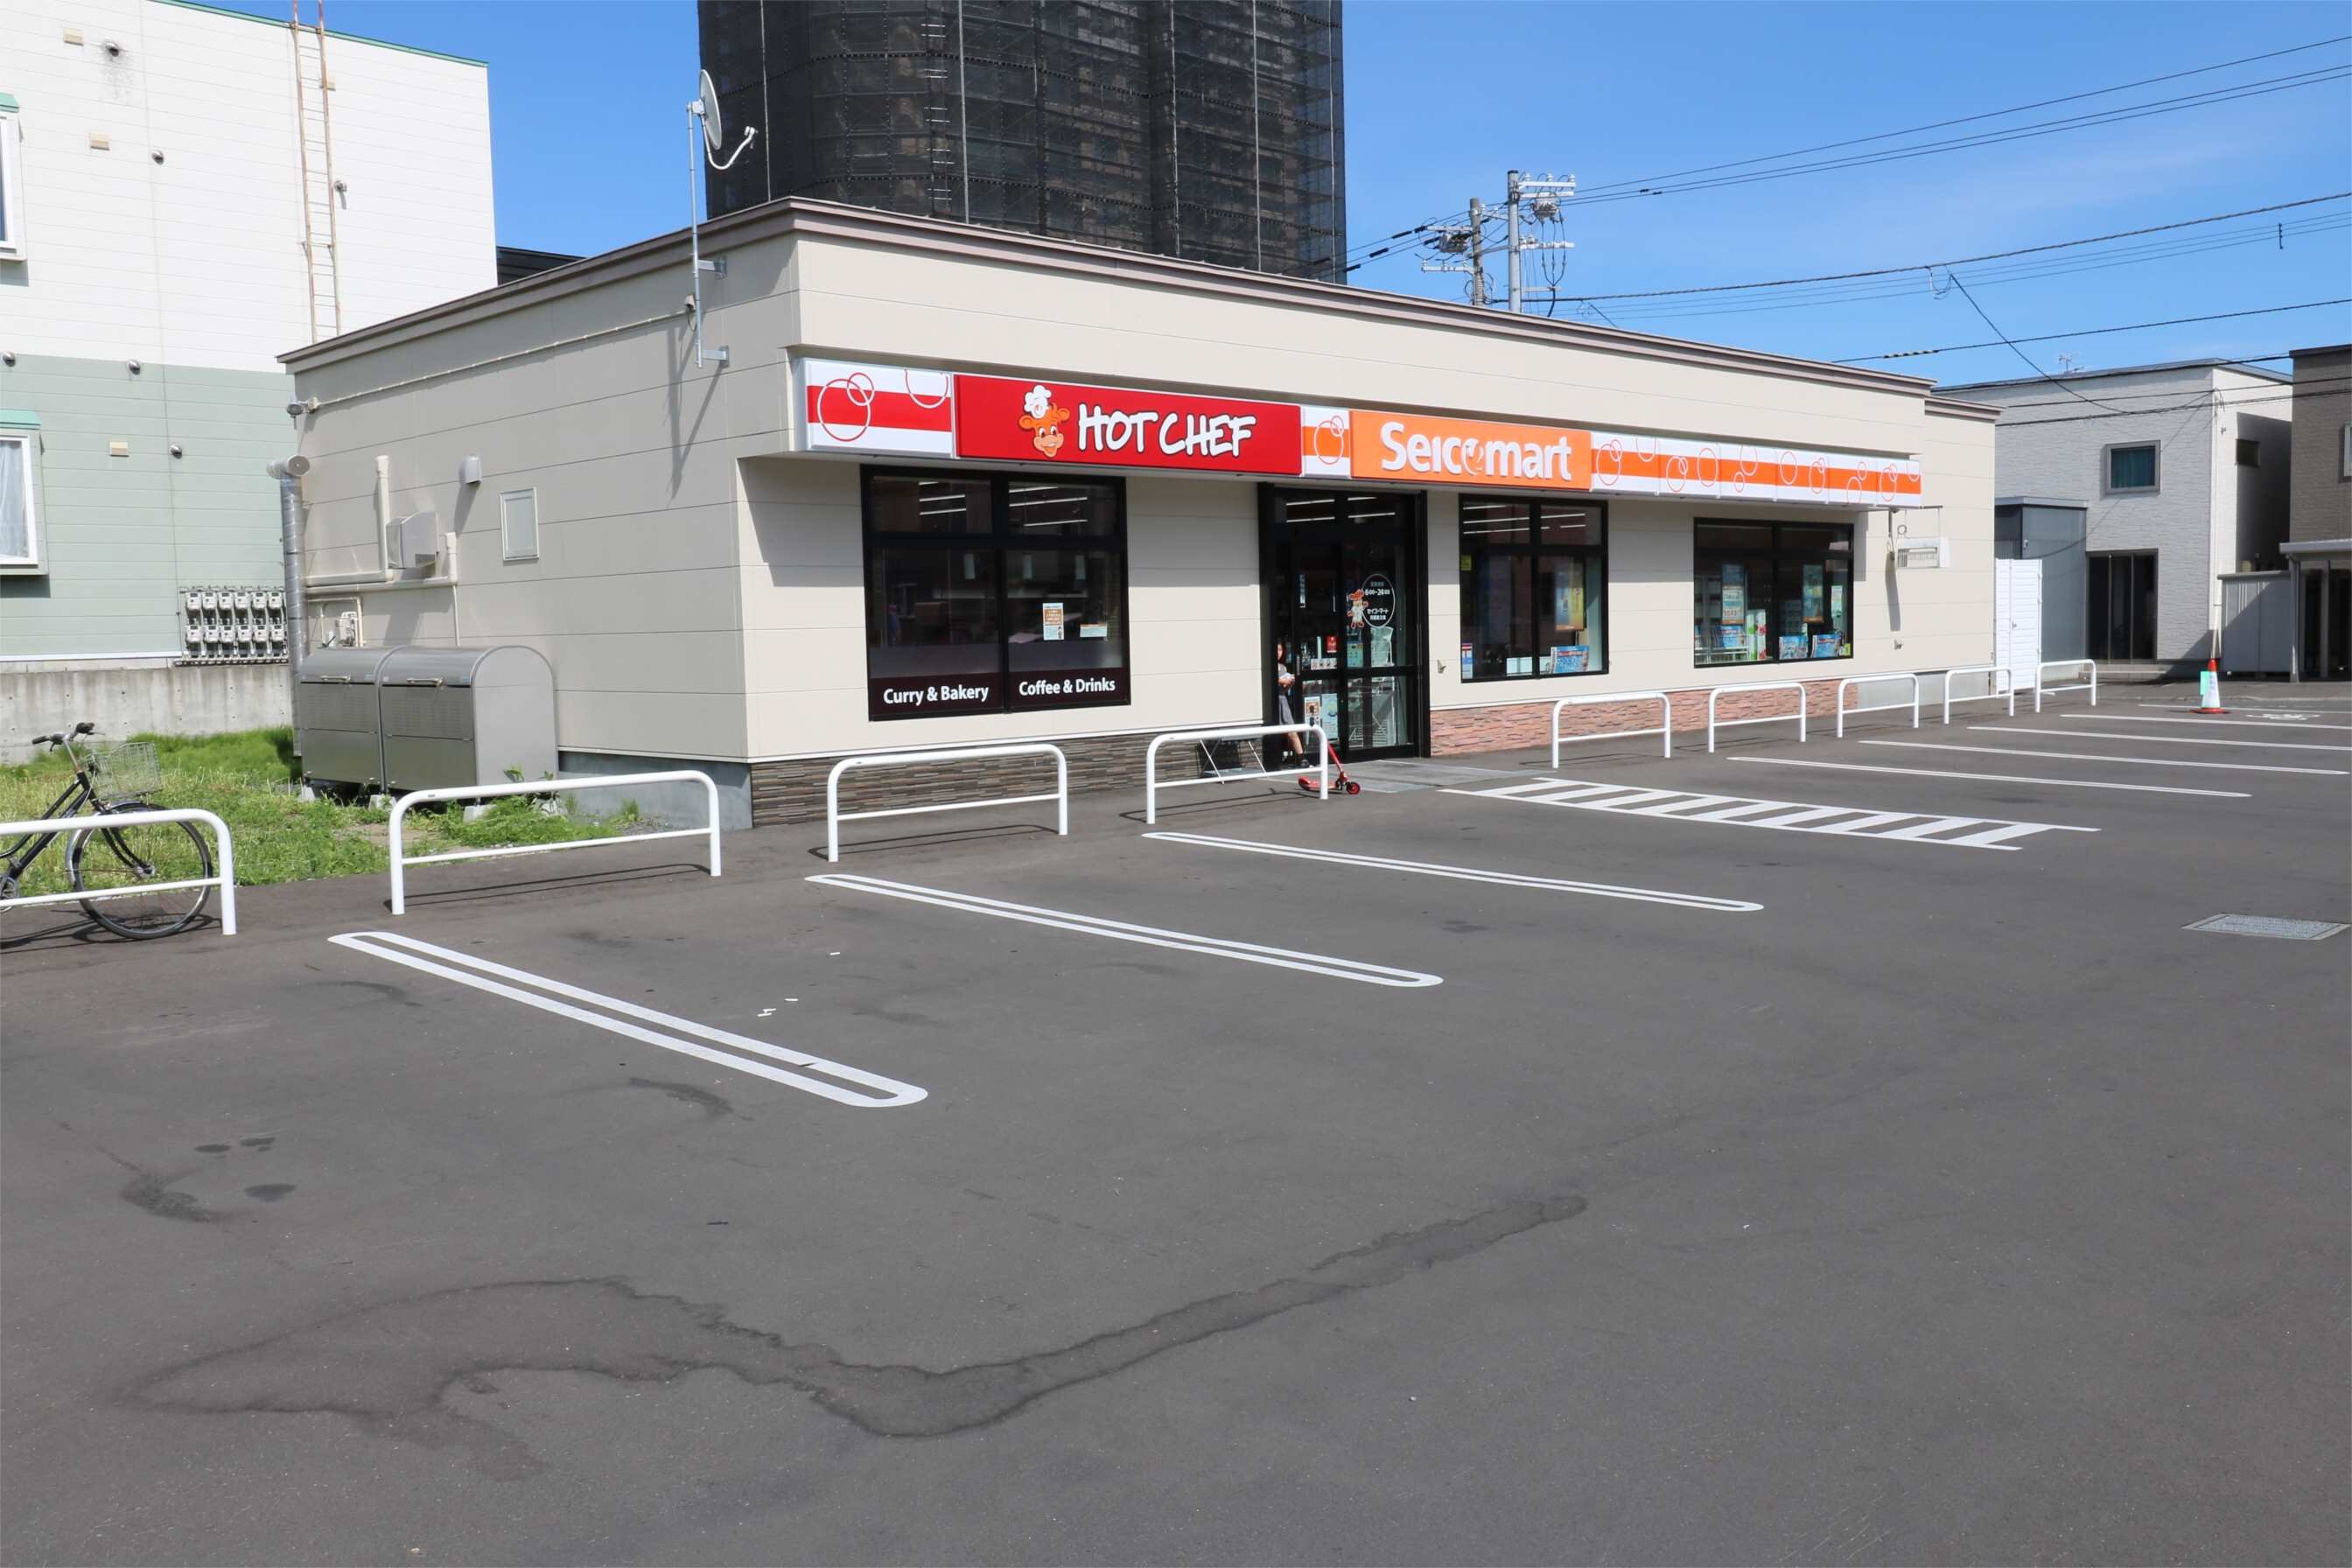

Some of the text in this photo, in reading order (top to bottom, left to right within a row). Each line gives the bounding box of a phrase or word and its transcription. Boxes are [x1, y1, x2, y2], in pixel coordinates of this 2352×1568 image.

[1077, 404, 1256, 458] HOT CHEF
[1380, 421, 1572, 481] Seicomart
[883, 684, 990, 706] Curry & Bakery
[1018, 676, 1116, 696] Coffee & Drinks
